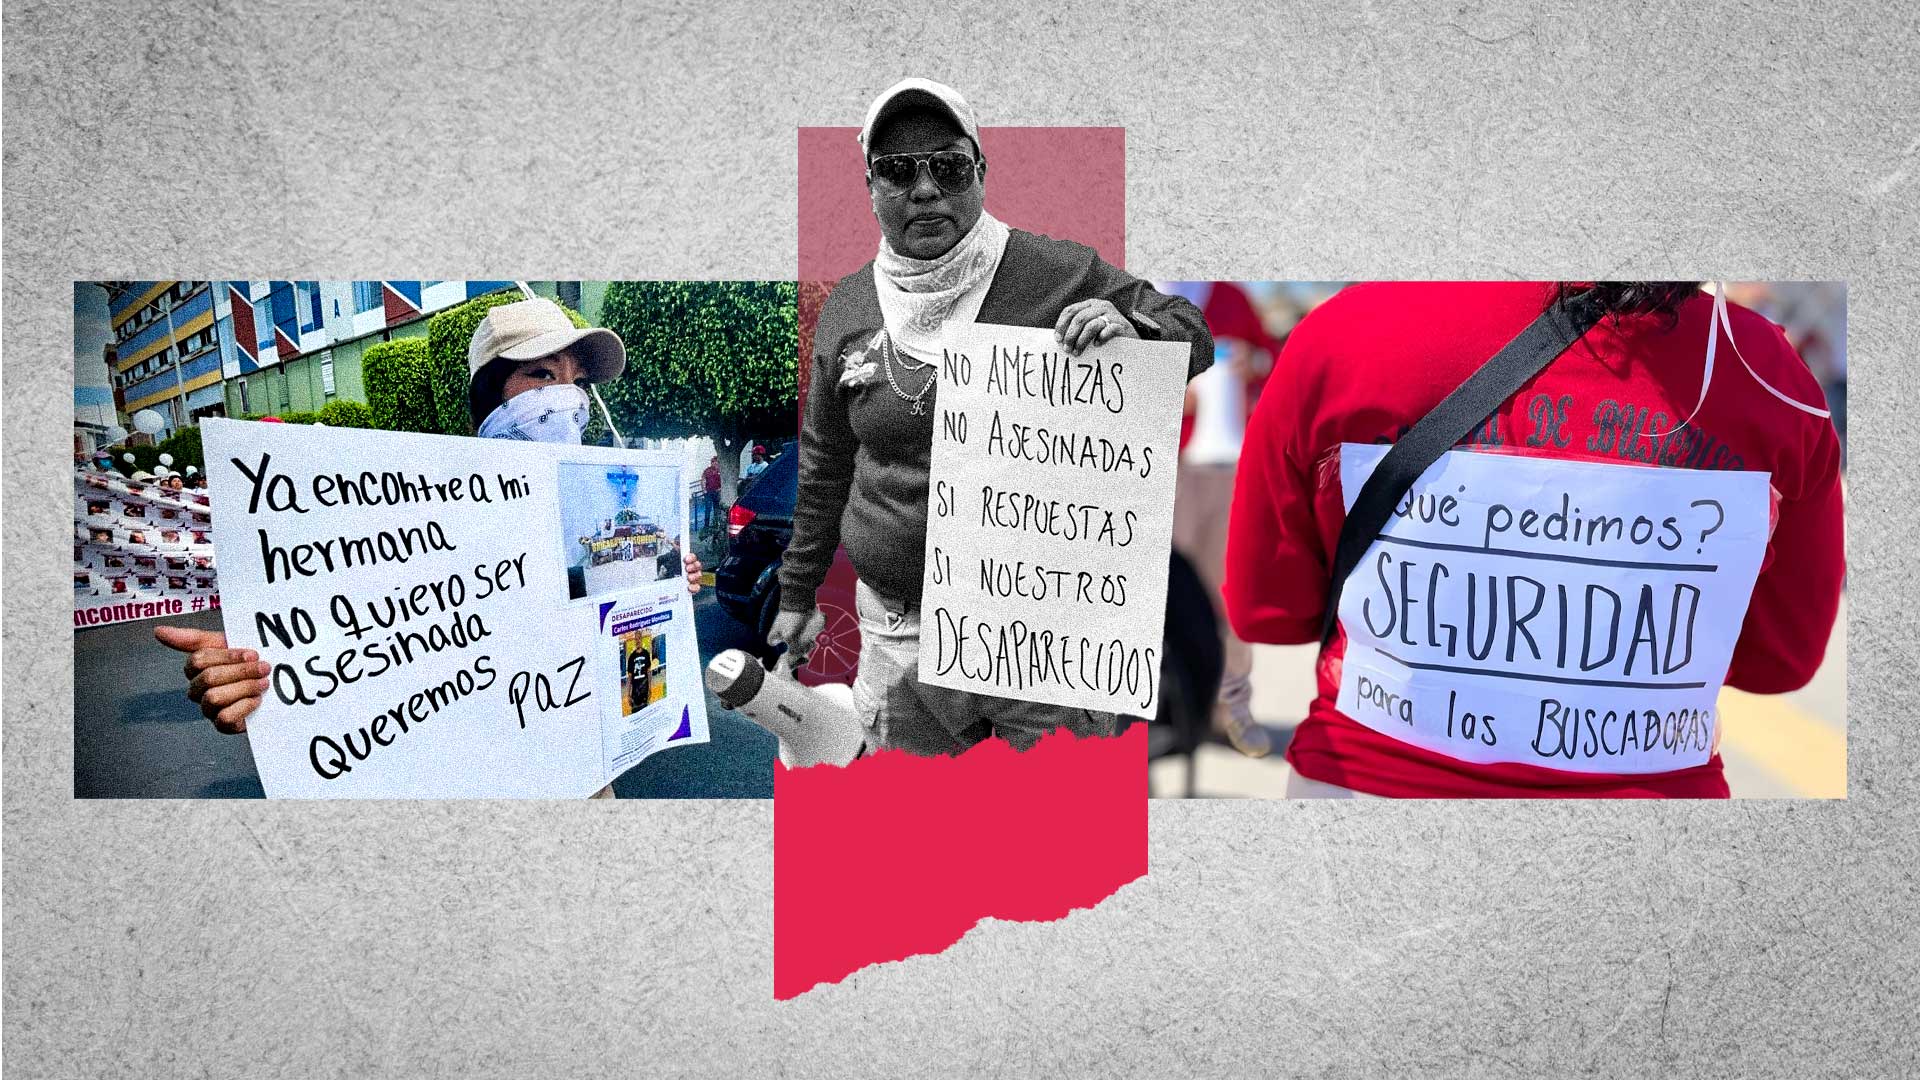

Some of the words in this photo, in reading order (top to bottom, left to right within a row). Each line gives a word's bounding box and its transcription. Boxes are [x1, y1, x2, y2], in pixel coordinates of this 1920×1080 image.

[944, 348, 971, 387] NO
[987, 345, 1124, 414] AMENAZAS
[944, 410, 968, 445] NO
[990, 411, 1152, 478] ASESINADAS
[1526, 394, 1573, 448] DE
[231, 453, 308, 513] Ya
[497, 474, 530, 501] mi
[937, 481, 955, 517] SI
[982, 486, 1137, 547] RESPUESTAS
[259, 521, 456, 584] hermana
[1485, 493, 1724, 555] pedimos?
[474, 553, 526, 600] ser
[933, 547, 952, 589] SI
[980, 557, 1127, 607] NUESTROS
[611, 606, 654, 623] DESAPARECIDO
[613, 624, 629, 634] Carlos
[1363, 552, 1701, 676] SEGURIDAD
[273, 611, 491, 706] asesinada
[935, 608, 1156, 709] DESAPARECIDOS
[310, 655, 497, 780] Queremos
[1357, 674, 1413, 727] para
[1447, 690, 1497, 747] las
[1531, 698, 1709, 760] BUSCADORAS
